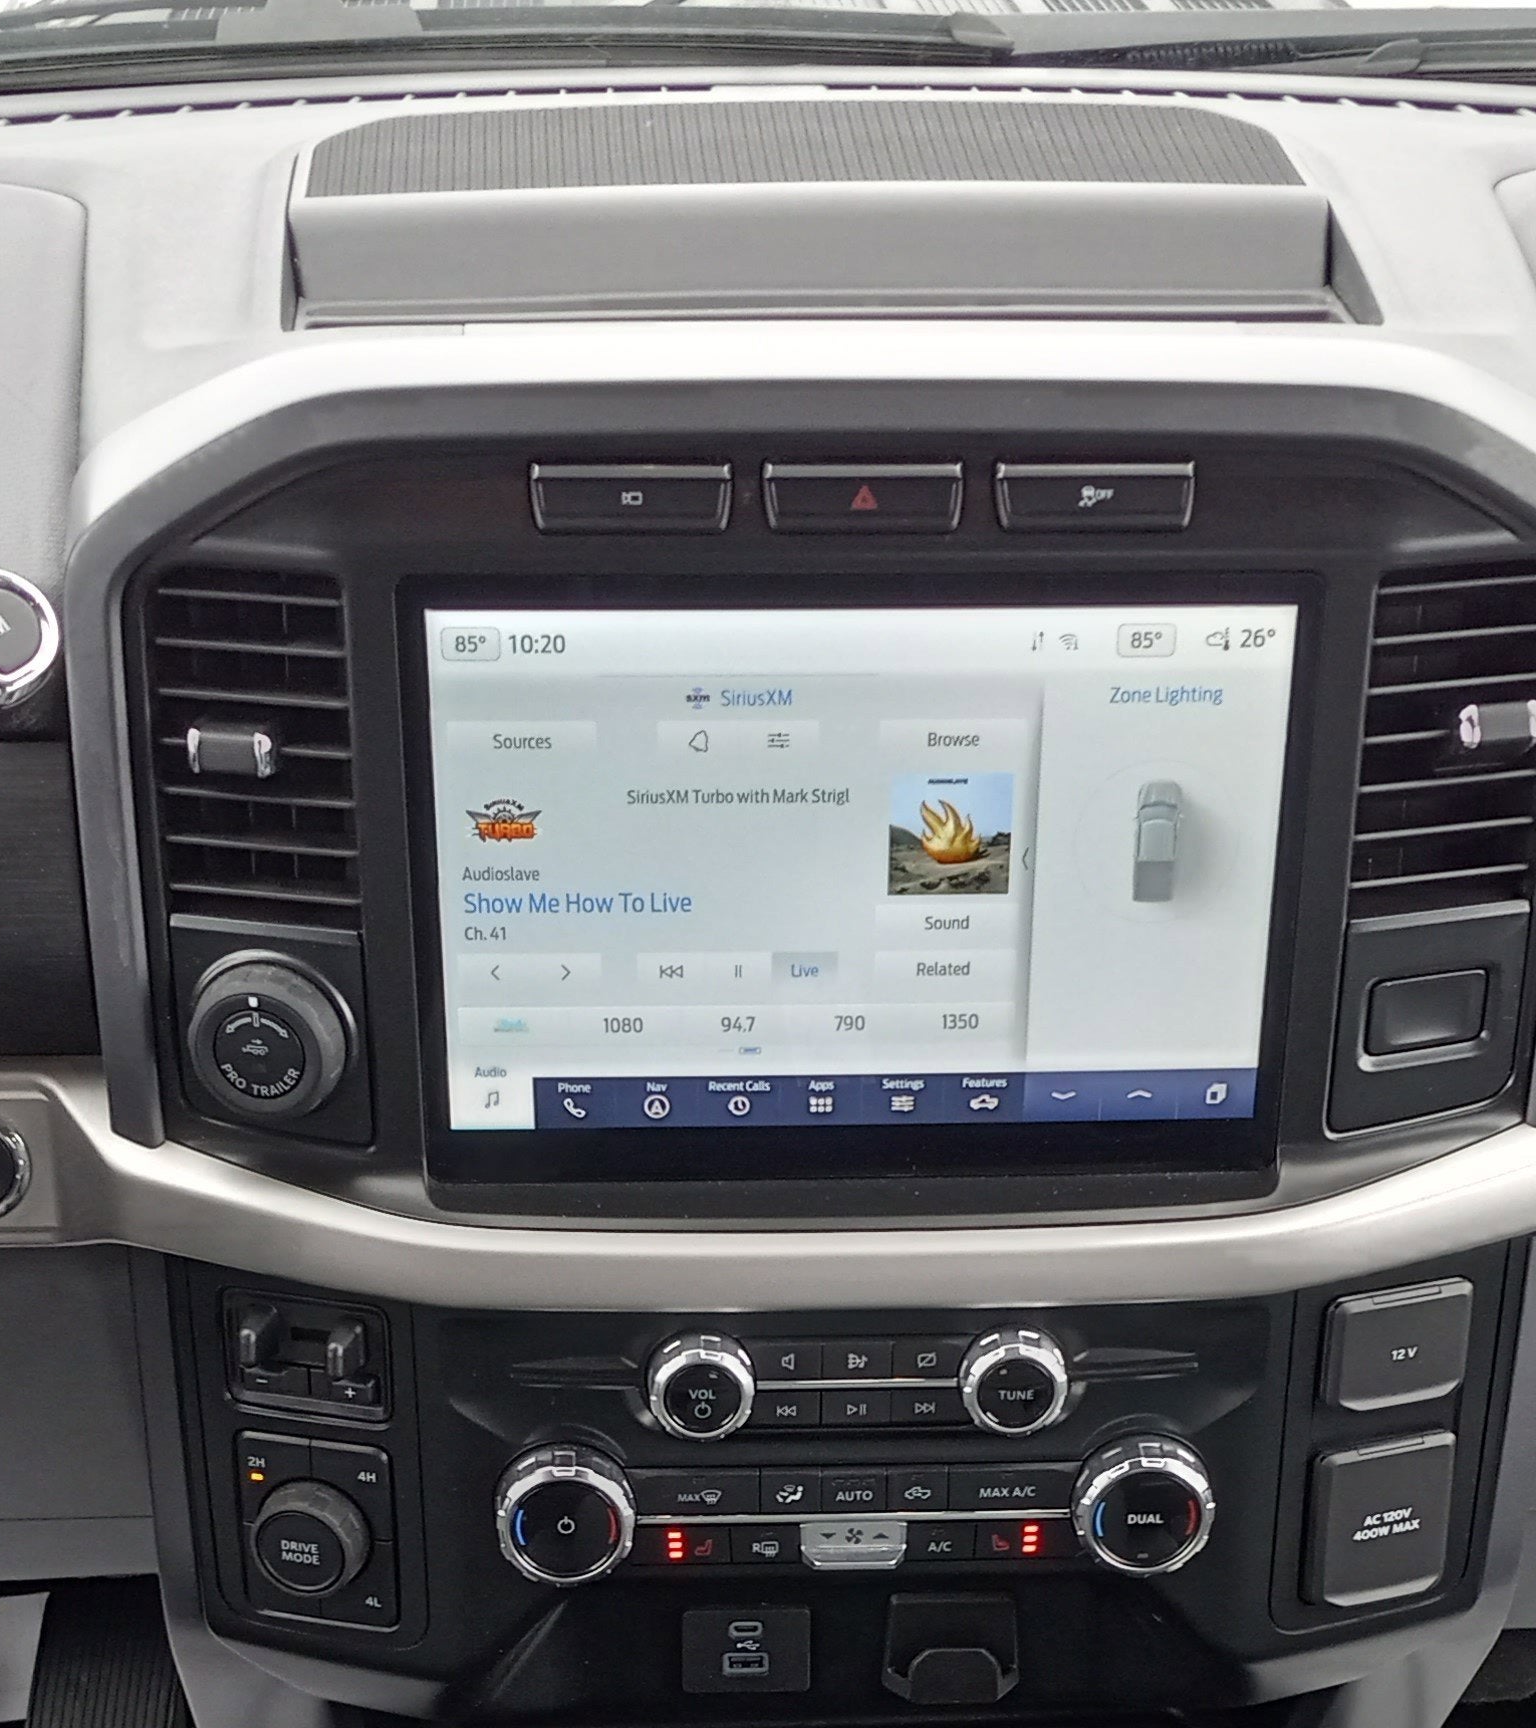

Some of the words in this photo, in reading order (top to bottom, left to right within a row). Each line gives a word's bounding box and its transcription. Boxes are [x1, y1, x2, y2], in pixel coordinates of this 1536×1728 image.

[1094, 488, 1114, 500] OFF
[454, 635, 486, 653] 85°
[508, 634, 566, 654] 10:20
[1130, 631, 1163, 649] 85°
[1240, 629, 1276, 649] 26°
[721, 689, 792, 707] SiriusXM
[1109, 687, 1151, 704] Zone
[1155, 686, 1223, 706] Lighting
[493, 733, 552, 750] Sources
[927, 731, 980, 748] Browse
[626, 789, 689, 805] SiriusXM
[693, 789, 734, 805] Turbo
[736, 789, 770, 804] with
[772, 788, 808, 804] Mark
[811, 787, 850, 807] Strigl
[476, 822, 535, 840] TURBO
[462, 866, 540, 882] Audioslave
[464, 892, 523, 914] Show
[529, 893, 559, 914] Me
[565, 893, 613, 914] How
[619, 893, 645, 913] To
[651, 892, 692, 913] Live
[924, 915, 970, 931] Sound
[464, 926, 488, 941] Ch.
[490, 926, 507, 941] 41
[790, 963, 819, 978] Live
[916, 962, 970, 977] Related
[602, 1017, 643, 1034] 1080
[721, 1016, 755, 1033] 94.7
[834, 1015, 866, 1032] 790
[941, 1013, 979, 1030] 1350
[474, 1066, 507, 1078] Audio
[221, 1063, 247, 1089] PRO
[251, 1067, 301, 1097] TRAILER
[557, 1081, 591, 1094] Phone
[646, 1081, 668, 1093] Nav
[708, 1080, 741, 1093] Recent
[743, 1079, 771, 1092] Calls
[808, 1080, 834, 1094] Apps
[881, 1077, 925, 1092] Settings
[962, 1077, 1007, 1089] Features
[688, 1389, 716, 1400] VOL
[998, 1389, 1034, 1400] TUNE
[247, 1456, 266, 1468] 2H
[357, 1471, 376, 1483] 4H
[677, 1493, 701, 1503] MAX
[835, 1490, 873, 1501] AUTO
[979, 1487, 1008, 1498] MAX
[1011, 1485, 1036, 1498] A/C
[1127, 1513, 1164, 1524] DUAL
[1363, 1514, 1382, 1527] AC
[1382, 1508, 1412, 1524] 120V
[1353, 1525, 1391, 1542] 400W
[1392, 1518, 1420, 1535] MAX
[280, 1540, 319, 1554] DRIVE
[927, 1541, 952, 1553] A/C
[281, 1551, 320, 1565] MODE
[365, 1596, 382, 1608] 4L
